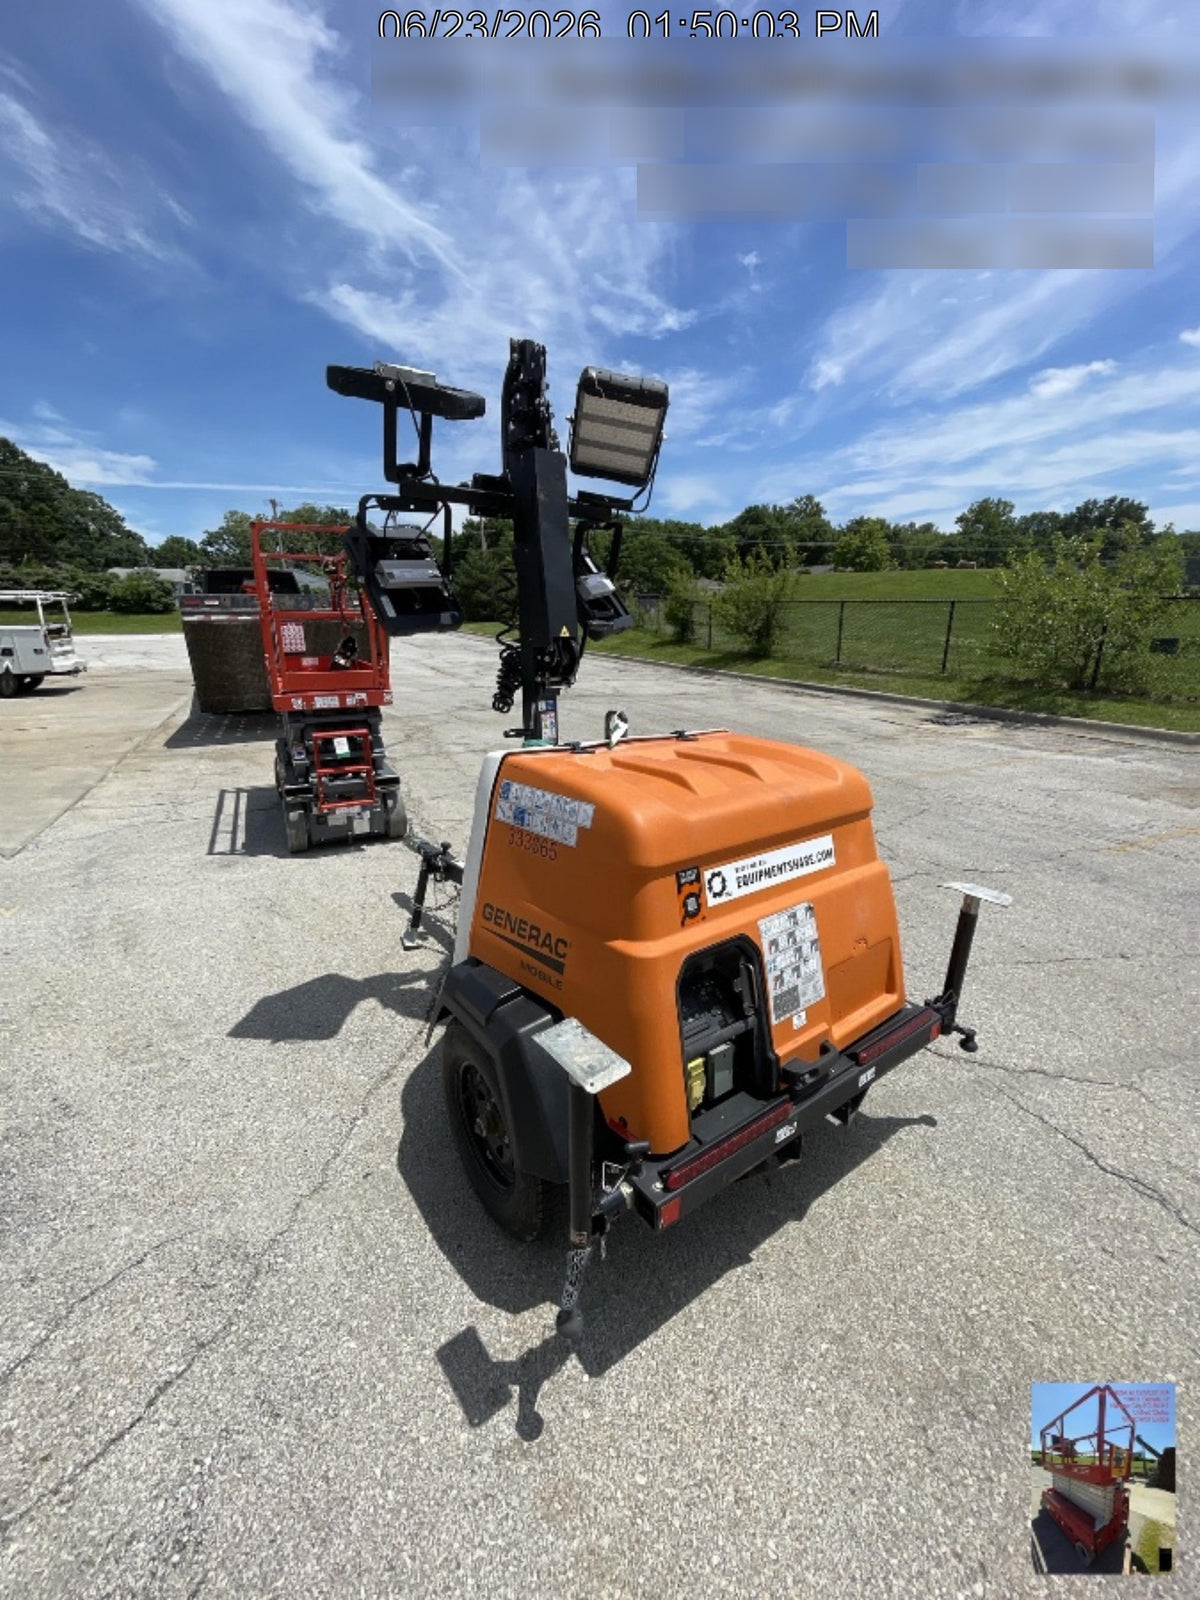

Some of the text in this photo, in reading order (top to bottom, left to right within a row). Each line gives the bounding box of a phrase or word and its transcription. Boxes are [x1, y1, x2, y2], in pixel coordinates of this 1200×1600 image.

[735, 847, 833, 889] EQUIPMENTSHARE.COM
[482, 901, 569, 960] GENERAC
[520, 959, 564, 992] MOBILE
